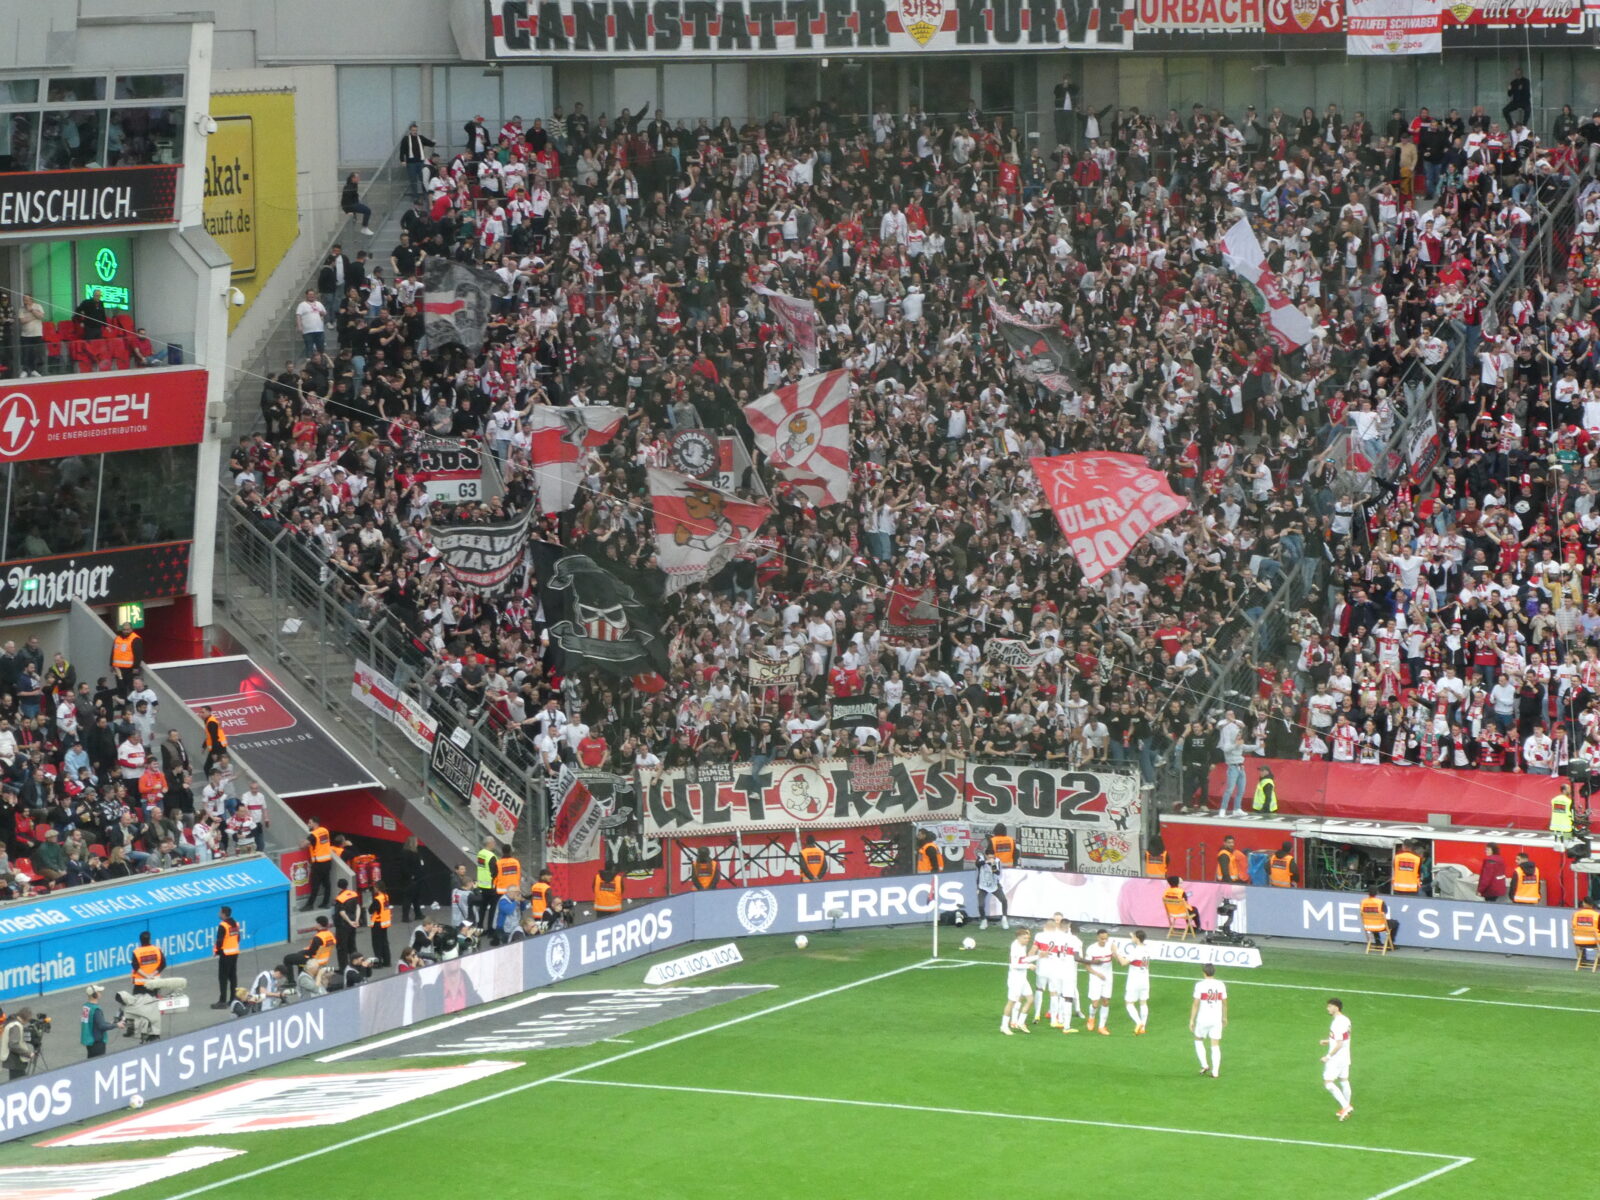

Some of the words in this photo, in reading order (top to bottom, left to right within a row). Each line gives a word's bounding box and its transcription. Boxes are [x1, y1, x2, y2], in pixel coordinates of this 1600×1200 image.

[503, 0, 890, 50] CANNSTATTER
[956, 0, 1125, 44] KURVE
[1140, 0, 1260, 24] URBACH
[0, 186, 137, 225] ENSCHLICH.
[48, 392, 150, 429] NRG24
[47, 432, 61, 441] DIE
[62, 425, 147, 440] ENERGIEDISTRIBUTION
[458, 482, 477, 498] G3
[1059, 474, 1160, 534] ULTRAS
[211, 704, 266, 719] ENROTH
[221, 717, 249, 728] ARE
[480, 771, 521, 817] HESSEN
[973, 766, 1101, 822] SO2
[1020, 827, 1067, 840] ULTRAS
[797, 880, 965, 922] LERROS
[580, 907, 673, 965] LERROS
[0, 1079, 72, 1131] ROS
[203, 1008, 324, 1074] FASHION
